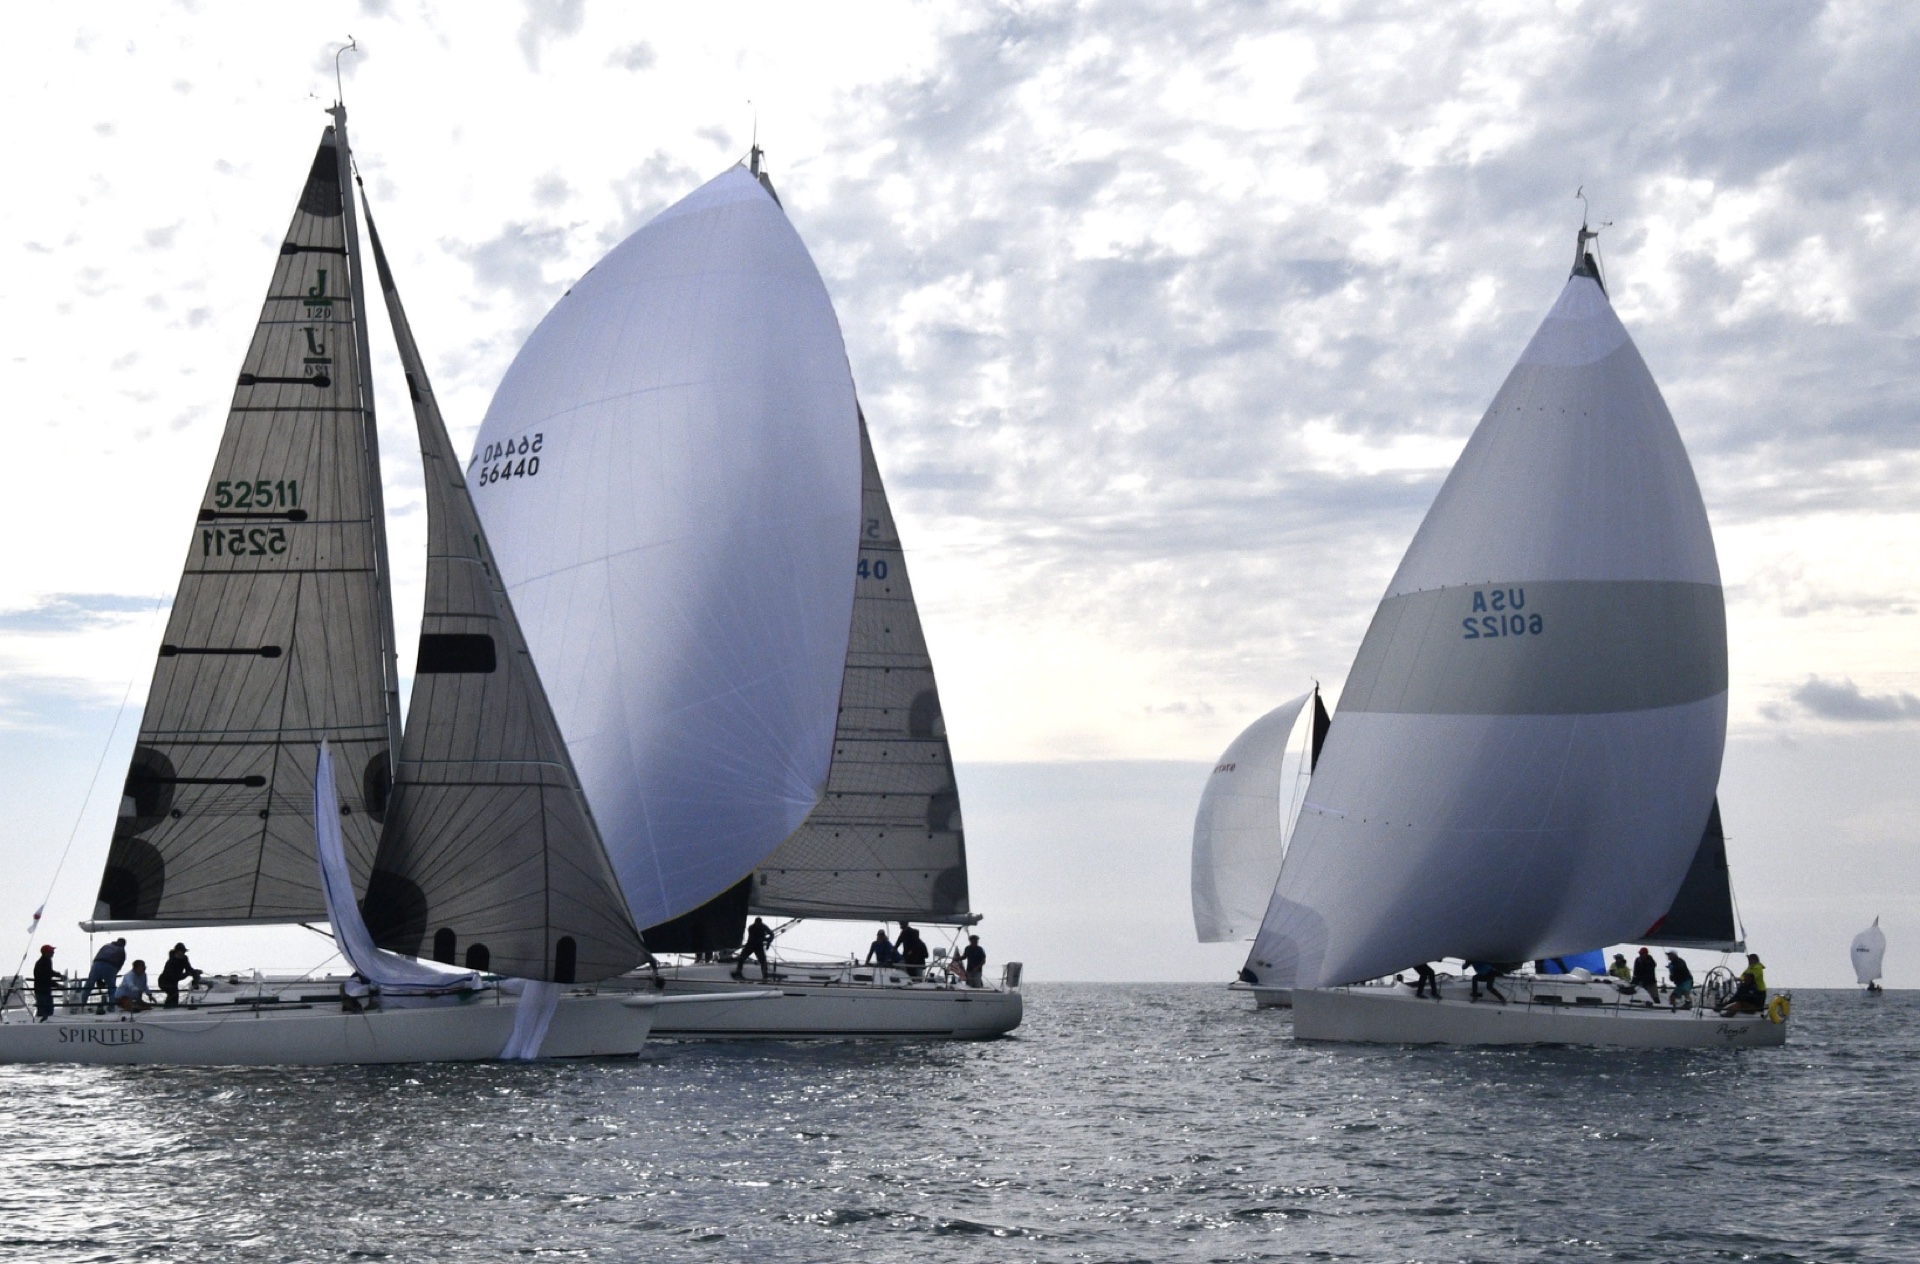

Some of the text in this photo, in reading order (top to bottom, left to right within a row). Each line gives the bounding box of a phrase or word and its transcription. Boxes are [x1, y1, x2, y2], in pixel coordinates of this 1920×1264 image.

[306, 307, 332, 319] 120
[479, 455, 540, 488] 56440
[214, 480, 298, 509] 52511
